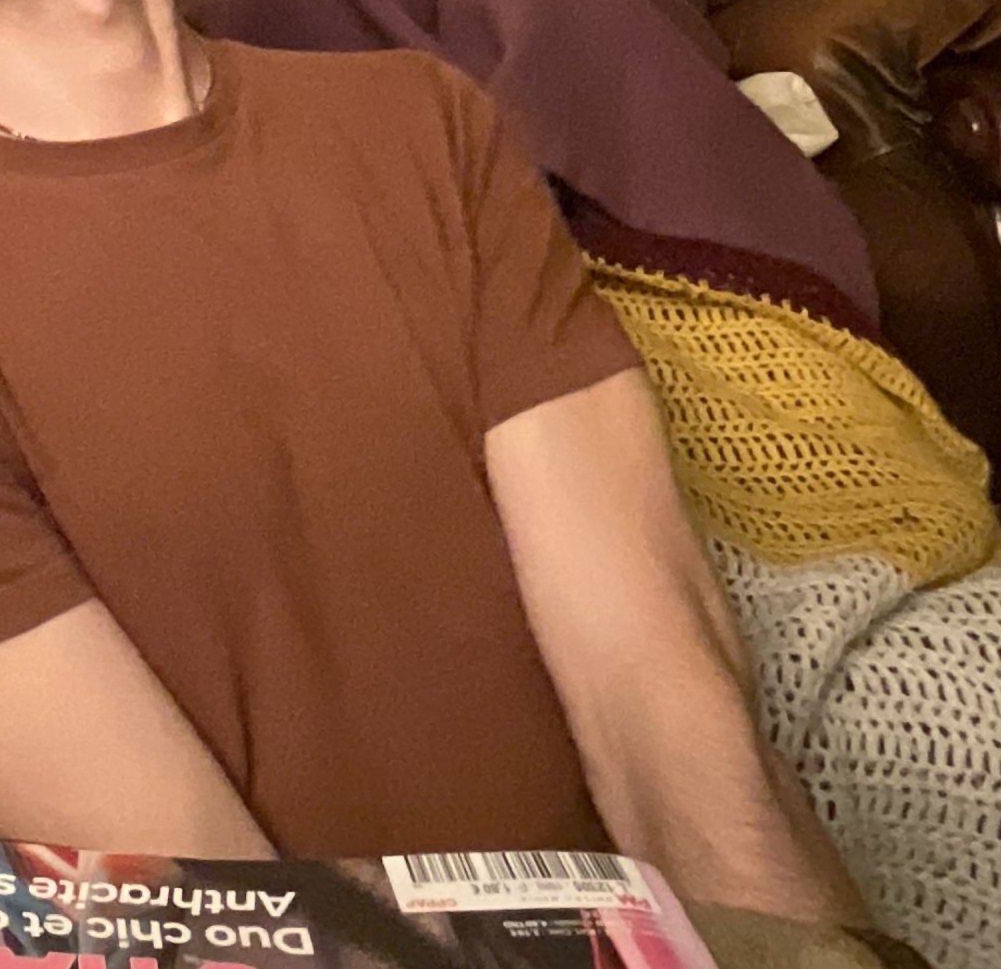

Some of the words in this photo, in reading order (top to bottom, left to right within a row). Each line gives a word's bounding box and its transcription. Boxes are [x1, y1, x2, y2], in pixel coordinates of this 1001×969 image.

[28, 876, 296, 918] Anthracite
[22, 911, 73, 938] et
[86, 916, 192, 950] chic
[205, 925, 314, 955] Duo
